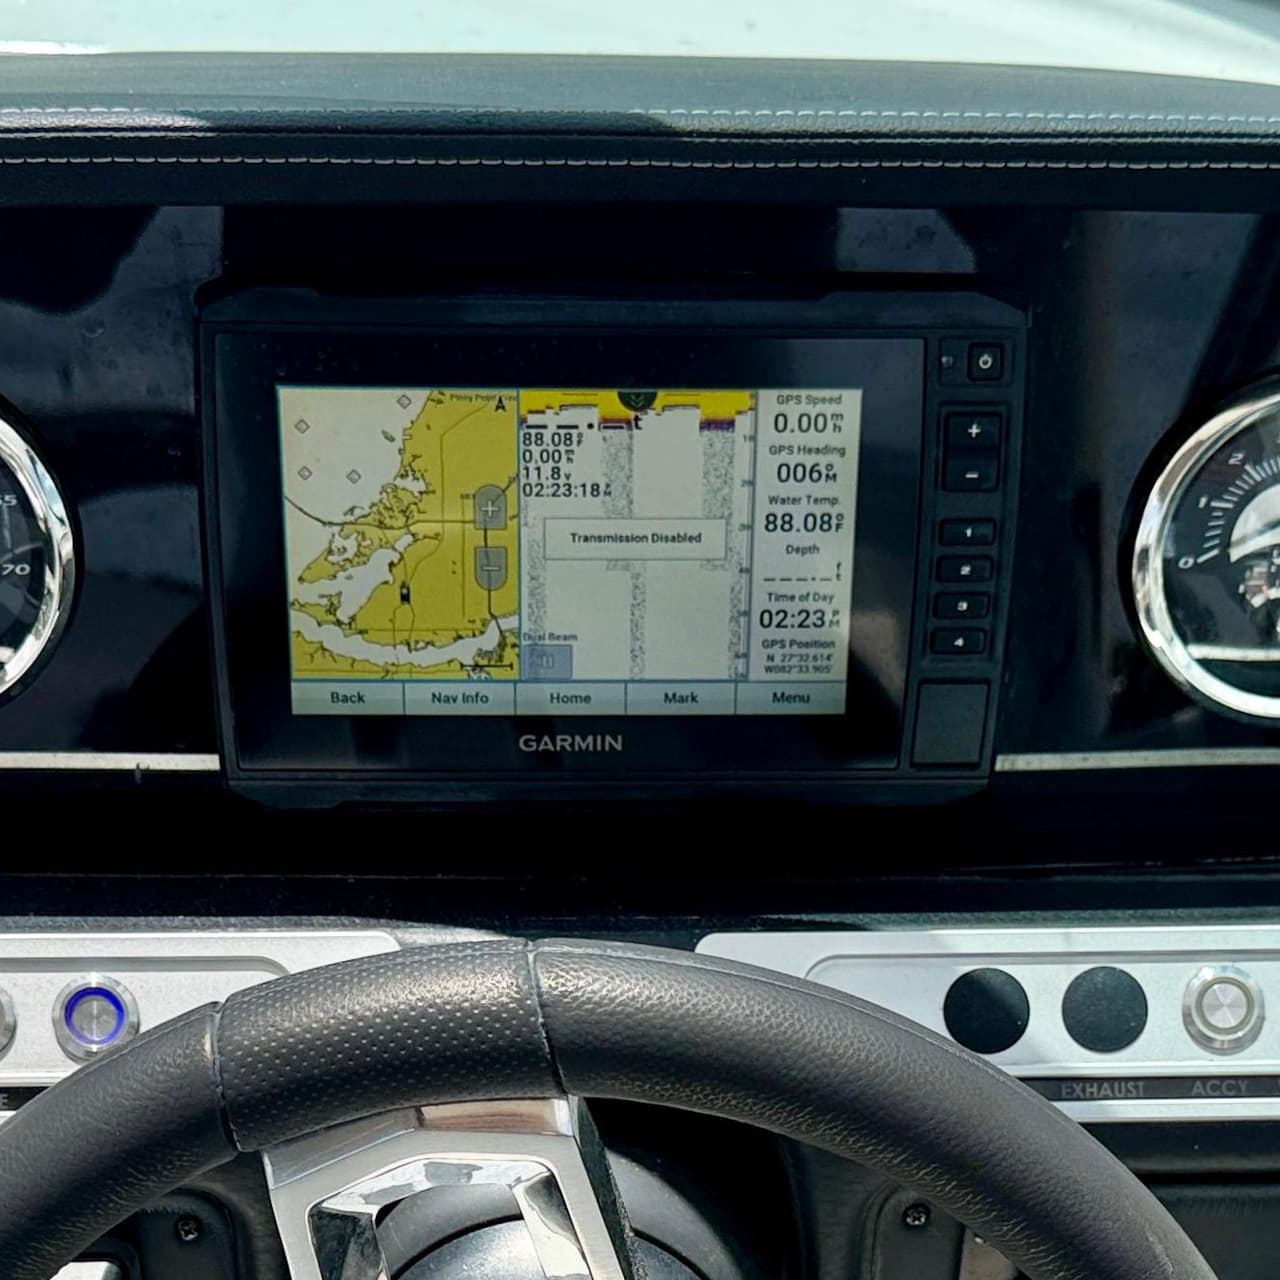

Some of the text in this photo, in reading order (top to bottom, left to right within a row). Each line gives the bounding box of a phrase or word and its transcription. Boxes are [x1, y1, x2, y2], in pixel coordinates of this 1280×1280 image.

[776, 395, 842, 407] GPS Speed
[773, 413, 827, 433] 0.00
[523, 449, 562, 464] 0.00
[769, 445, 847, 458] GPS Heading
[1228, 453, 1245, 465] 2
[776, 463, 823, 483] 006
[523, 483, 601, 498] 02:23:18
[768, 495, 801, 506] Water
[764, 512, 832, 533] 88.08
[570, 532, 702, 543] Transmission Disabled
[785, 544, 820, 557] Depth
[1, 563, 31, 576] 70
[960, 564, 972, 576] 2
[1178, 557, 1194, 570] 0
[767, 592, 835, 605] Time of Day
[956, 601, 968, 612] 3
[759, 608, 826, 629] 02:23
[523, 632, 578, 642] Dual Beam
[761, 638, 836, 649] GPS Position
[953, 637, 964, 647] 4
[330, 691, 366, 704] Back
[431, 691, 489, 704] Nav Info
[549, 692, 592, 704] Home
[664, 692, 699, 704] Mark
[772, 692, 811, 704] Menu
[518, 734, 623, 752] GARMIN
[1060, 1081, 1145, 1099] EXHAUST
[1192, 1079, 1250, 1096] ACCY
